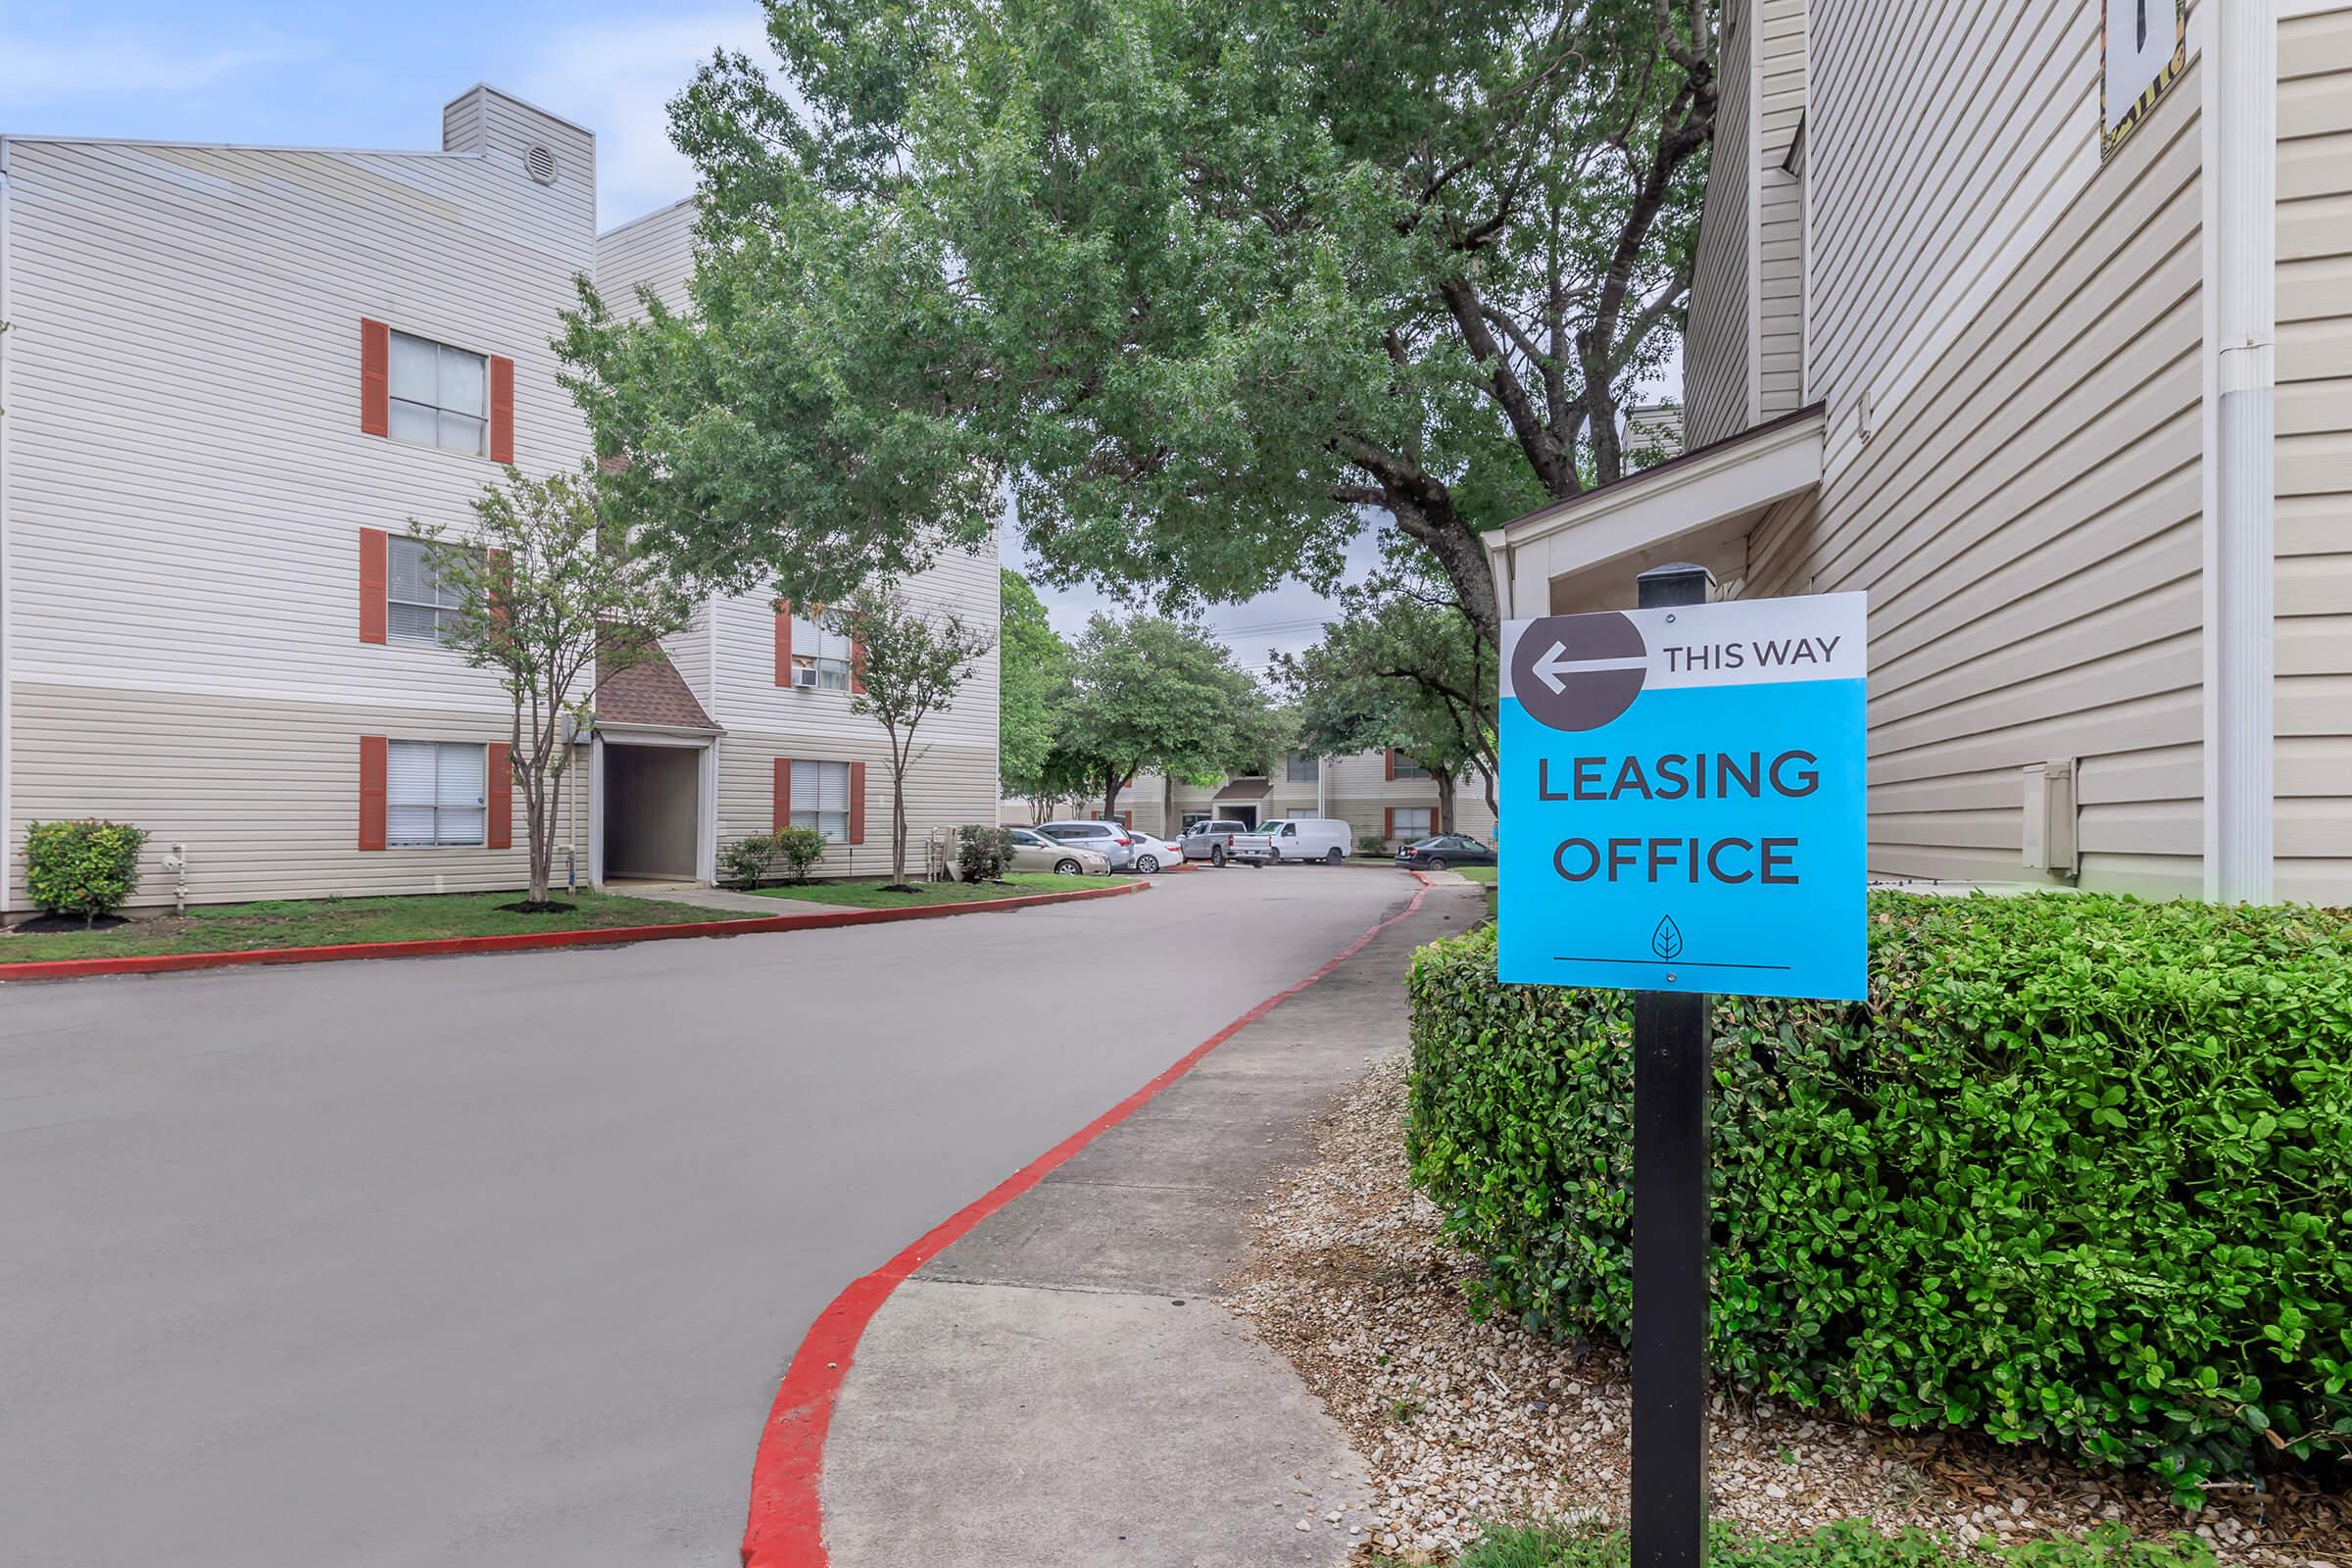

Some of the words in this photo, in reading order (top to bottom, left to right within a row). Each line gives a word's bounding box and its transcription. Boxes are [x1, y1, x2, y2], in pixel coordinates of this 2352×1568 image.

[1663, 643, 1743, 672] THIS
[1752, 635, 1841, 666] WAY
[1539, 750, 1820, 802] LEASING
[1553, 837, 1799, 885] OFFICE
